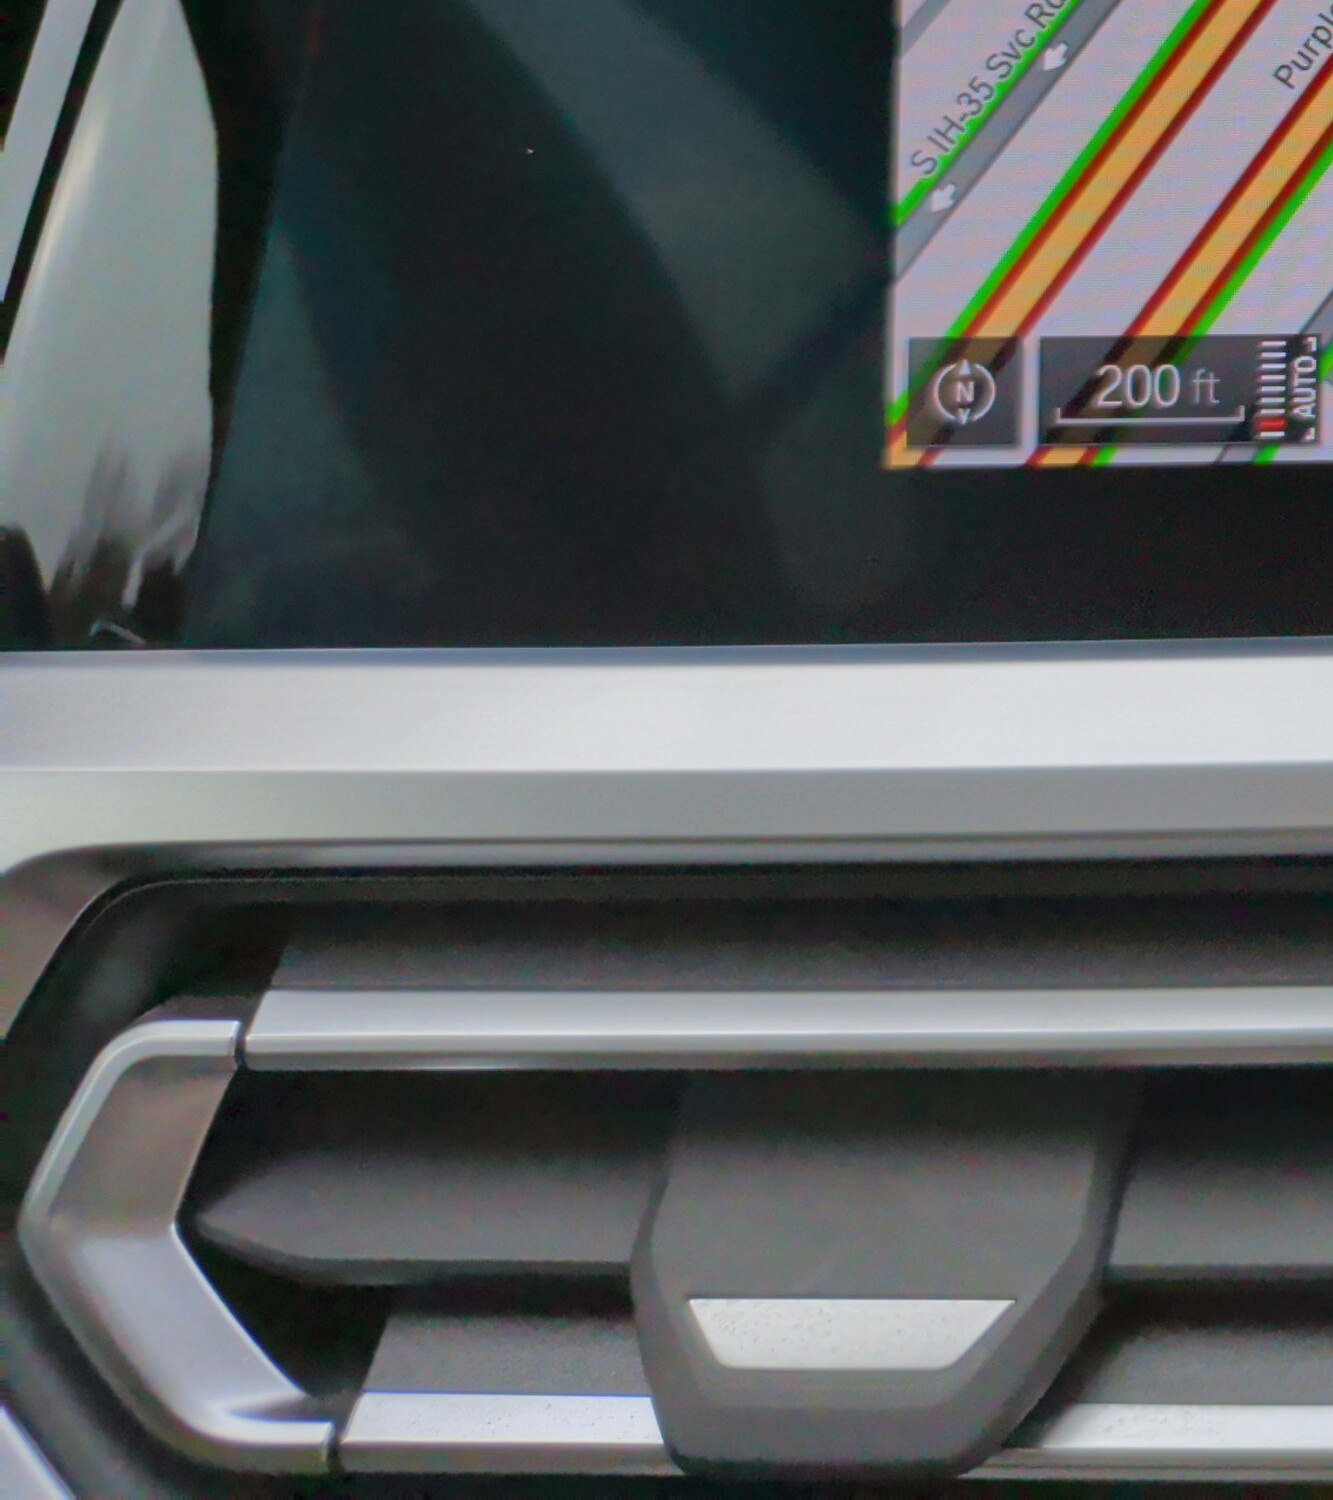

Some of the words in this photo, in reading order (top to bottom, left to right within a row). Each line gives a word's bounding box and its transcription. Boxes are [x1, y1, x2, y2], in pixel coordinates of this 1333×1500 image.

[909, 149, 939, 176] S
[926, 75, 995, 154] IH-35
[985, 28, 1036, 81] Svc
[954, 380, 976, 402] N
[1096, 363, 1181, 409] 200
[1191, 367, 1221, 406] ft
[1292, 355, 1318, 419] AUTO
